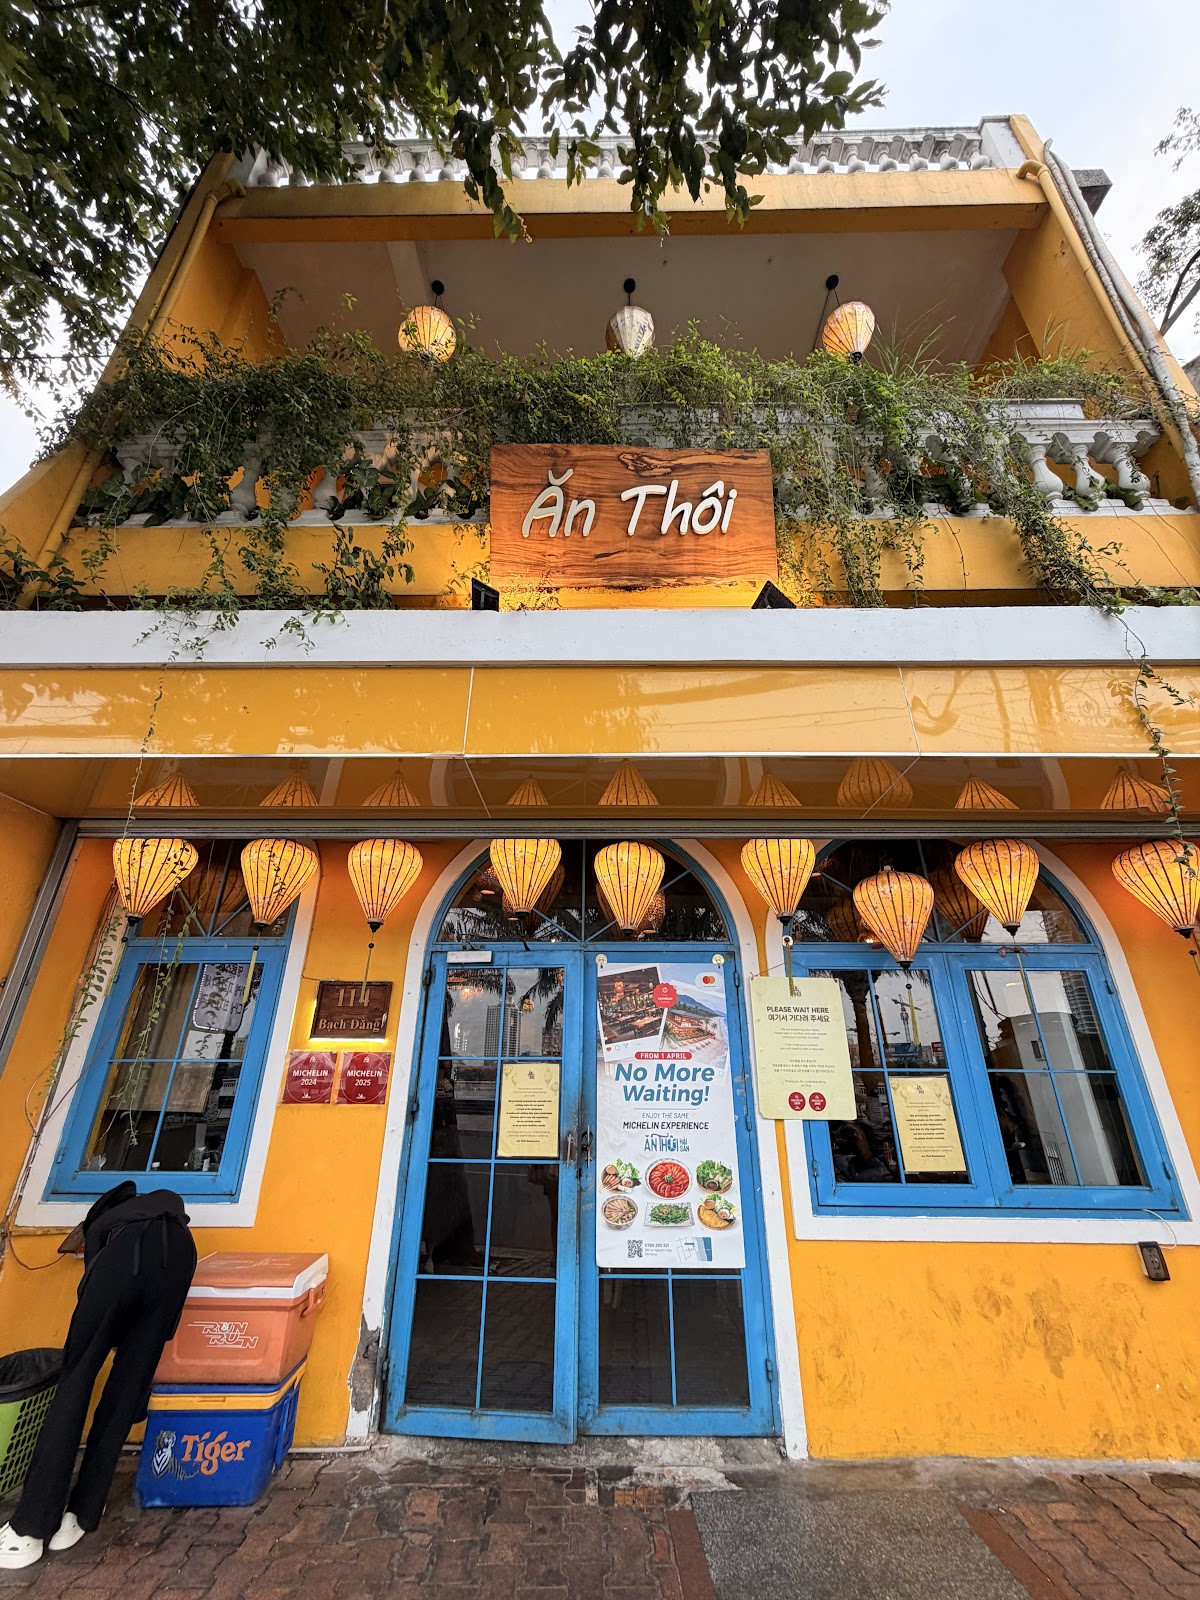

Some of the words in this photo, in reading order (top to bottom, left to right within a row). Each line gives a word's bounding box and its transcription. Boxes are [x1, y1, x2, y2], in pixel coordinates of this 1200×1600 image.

[521, 468, 595, 537] Ăn
[621, 479, 738, 536] Thôi
[318, 1018, 346, 1032] Bạch
[768, 1014, 788, 1022] 여기서
[789, 1014, 809, 1022] 기다려
[810, 1014, 830, 1023] 주세요
[292, 1069, 329, 1077] MICHELIN
[346, 1069, 383, 1077] MICHELIN
[614, 1063, 647, 1082] No
[654, 1063, 715, 1082] More
[300, 1078, 317, 1086] 2024
[354, 1078, 371, 1086] 2025
[622, 1083, 710, 1106] Waiting!
[622, 1121, 660, 1130] MICHELIN
[660, 1121, 710, 1130] EXPERIENCE
[197, 1321, 249, 1335] RUN
[206, 1333, 259, 1349] RUN
[180, 1431, 252, 1476] Tiger
